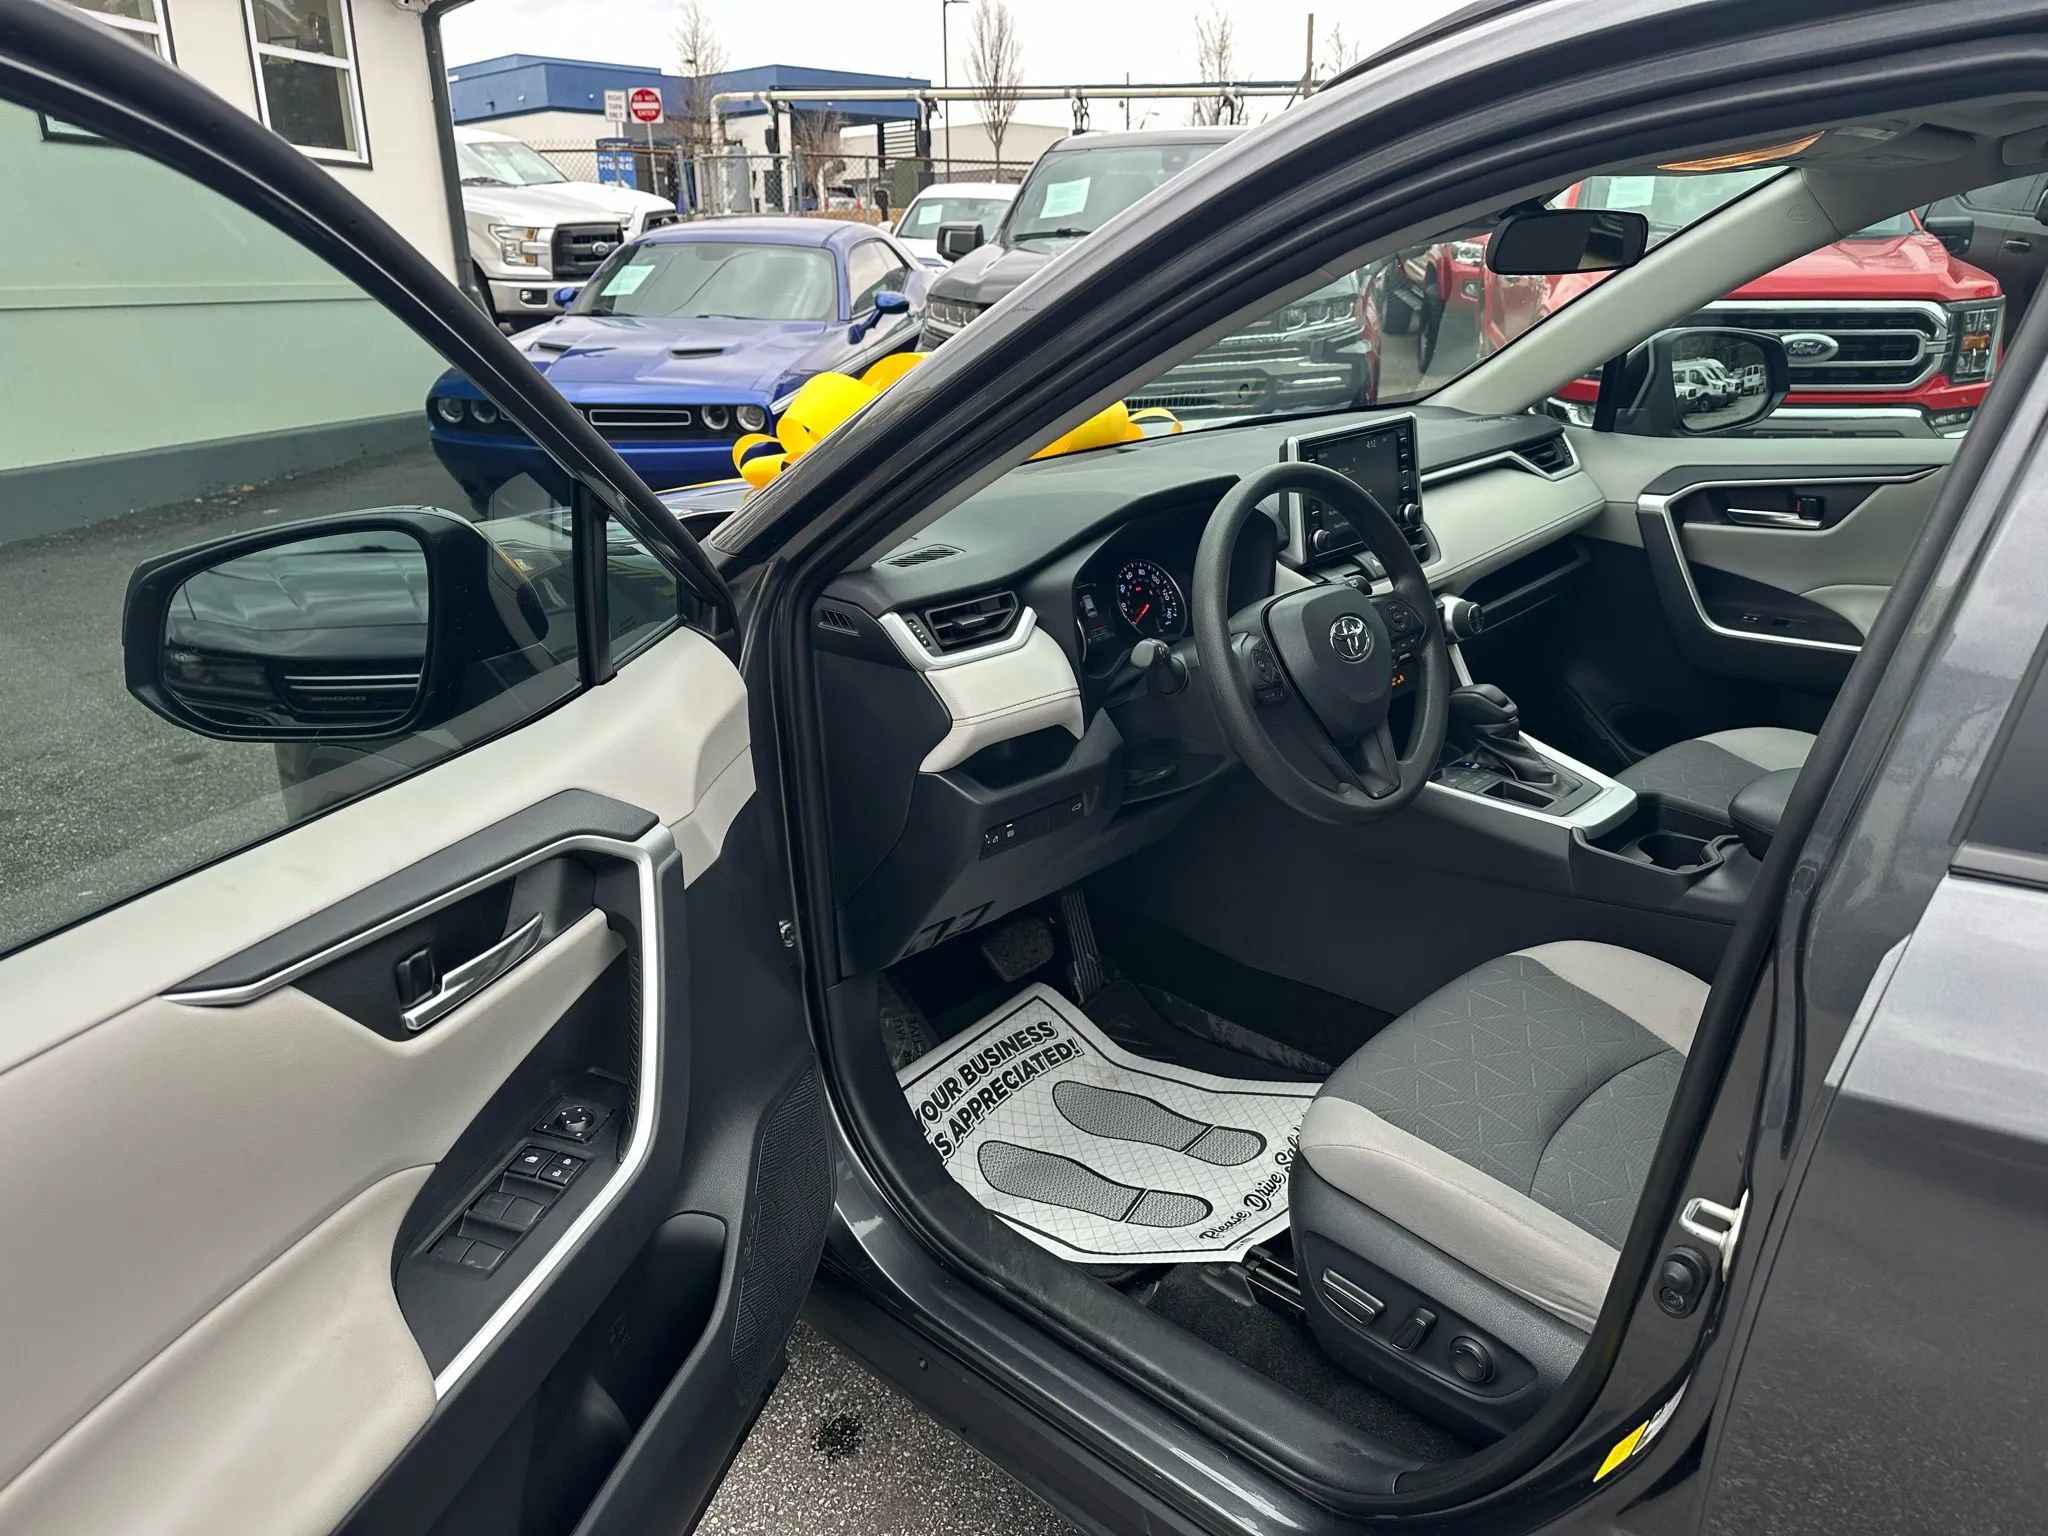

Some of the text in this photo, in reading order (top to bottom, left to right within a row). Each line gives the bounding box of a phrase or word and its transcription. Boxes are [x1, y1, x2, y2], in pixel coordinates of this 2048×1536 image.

[1788, 340, 1822, 355] Ford
[1152, 574, 1160, 585] 100
[1162, 588, 1170, 601] 120
[957, 1020, 1058, 1087] BUSINESS
[948, 1037, 1084, 1145] APPRECIATED!
[1199, 1211, 1251, 1239] Please
[1243, 1172, 1286, 1212] Drive
